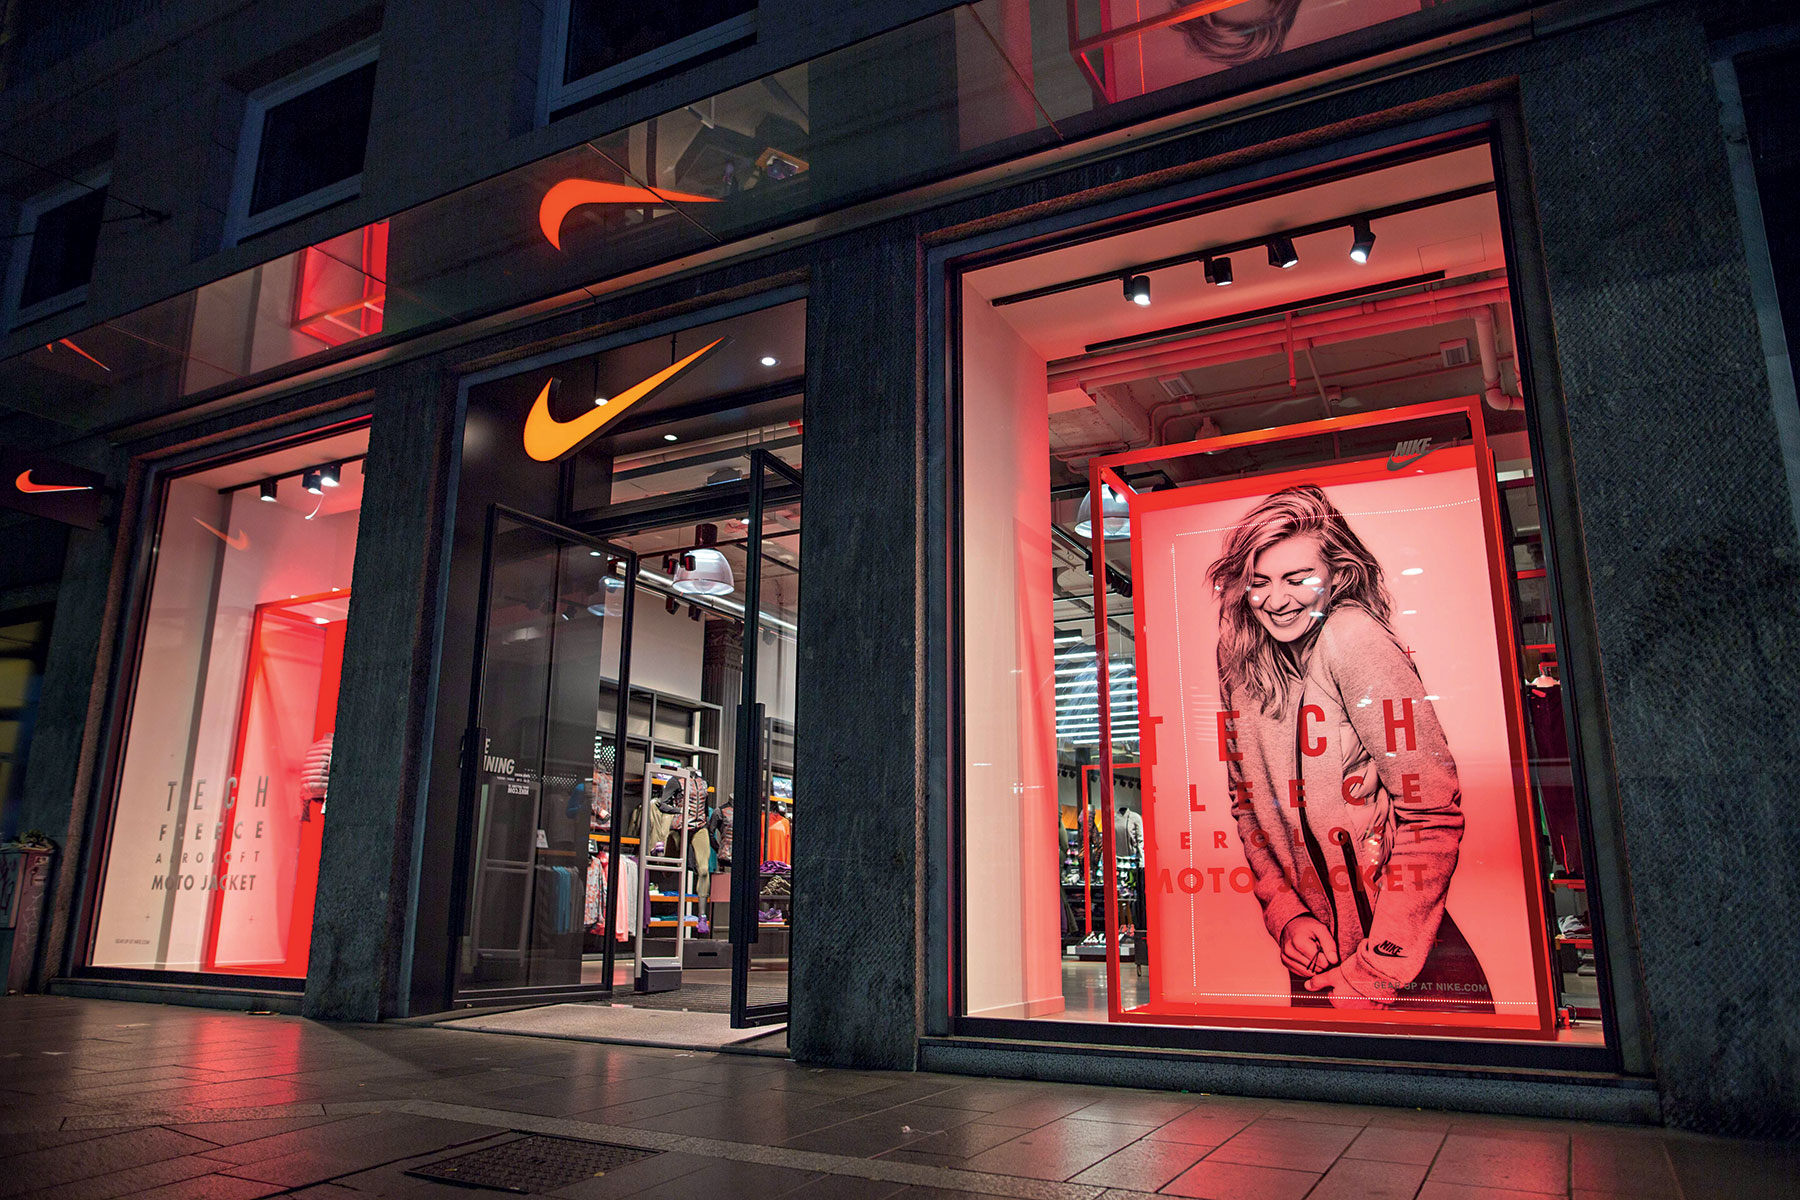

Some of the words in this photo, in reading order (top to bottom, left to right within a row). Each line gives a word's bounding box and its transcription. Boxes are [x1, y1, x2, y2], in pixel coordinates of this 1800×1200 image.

[1394, 437, 1432, 457] NIKE
[1145, 697, 1417, 766] TECH
[167, 775, 269, 812] TECH
[1150, 773, 1422, 812] LEECE
[155, 850, 260, 864] AROOFT
[151, 874, 194, 891] MOTO
[200, 874, 256, 891] JACKET
[1277, 864, 1428, 894] JACKET
[1379, 940, 1403, 956] NIKE
[1374, 981, 1401, 990] GEAR
[1404, 981, 1418, 991] UP
[1420, 981, 1434, 991] AT
[1436, 981, 1488, 993] NIKE.COM
